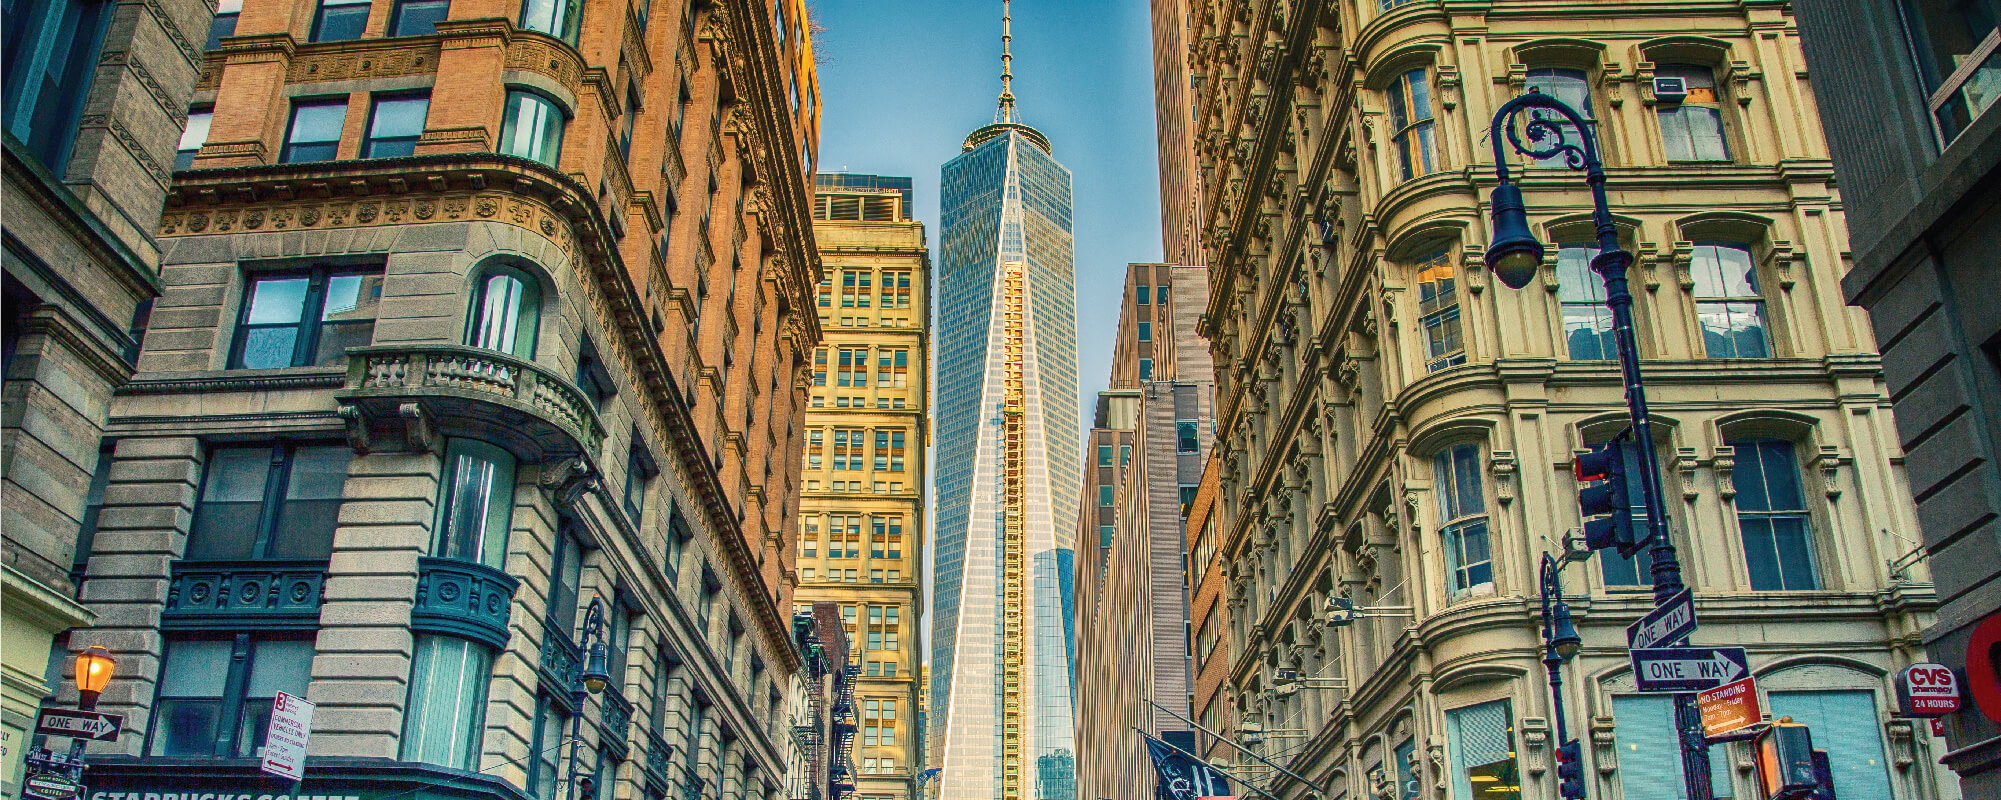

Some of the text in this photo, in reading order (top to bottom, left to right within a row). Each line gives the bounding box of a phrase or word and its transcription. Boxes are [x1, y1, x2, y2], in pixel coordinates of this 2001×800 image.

[1638, 605, 1685, 648] ONE WAY
[1650, 661, 1731, 679] ONE WAY
[1909, 668, 1951, 685] CVS
[1701, 684, 1746, 705] NO STANDING
[1911, 685, 1953, 694] pharmacy
[277, 693, 286, 710] 3
[1914, 699, 1955, 708] 24 HOURS
[48, 717, 108, 732] ONE WAY
